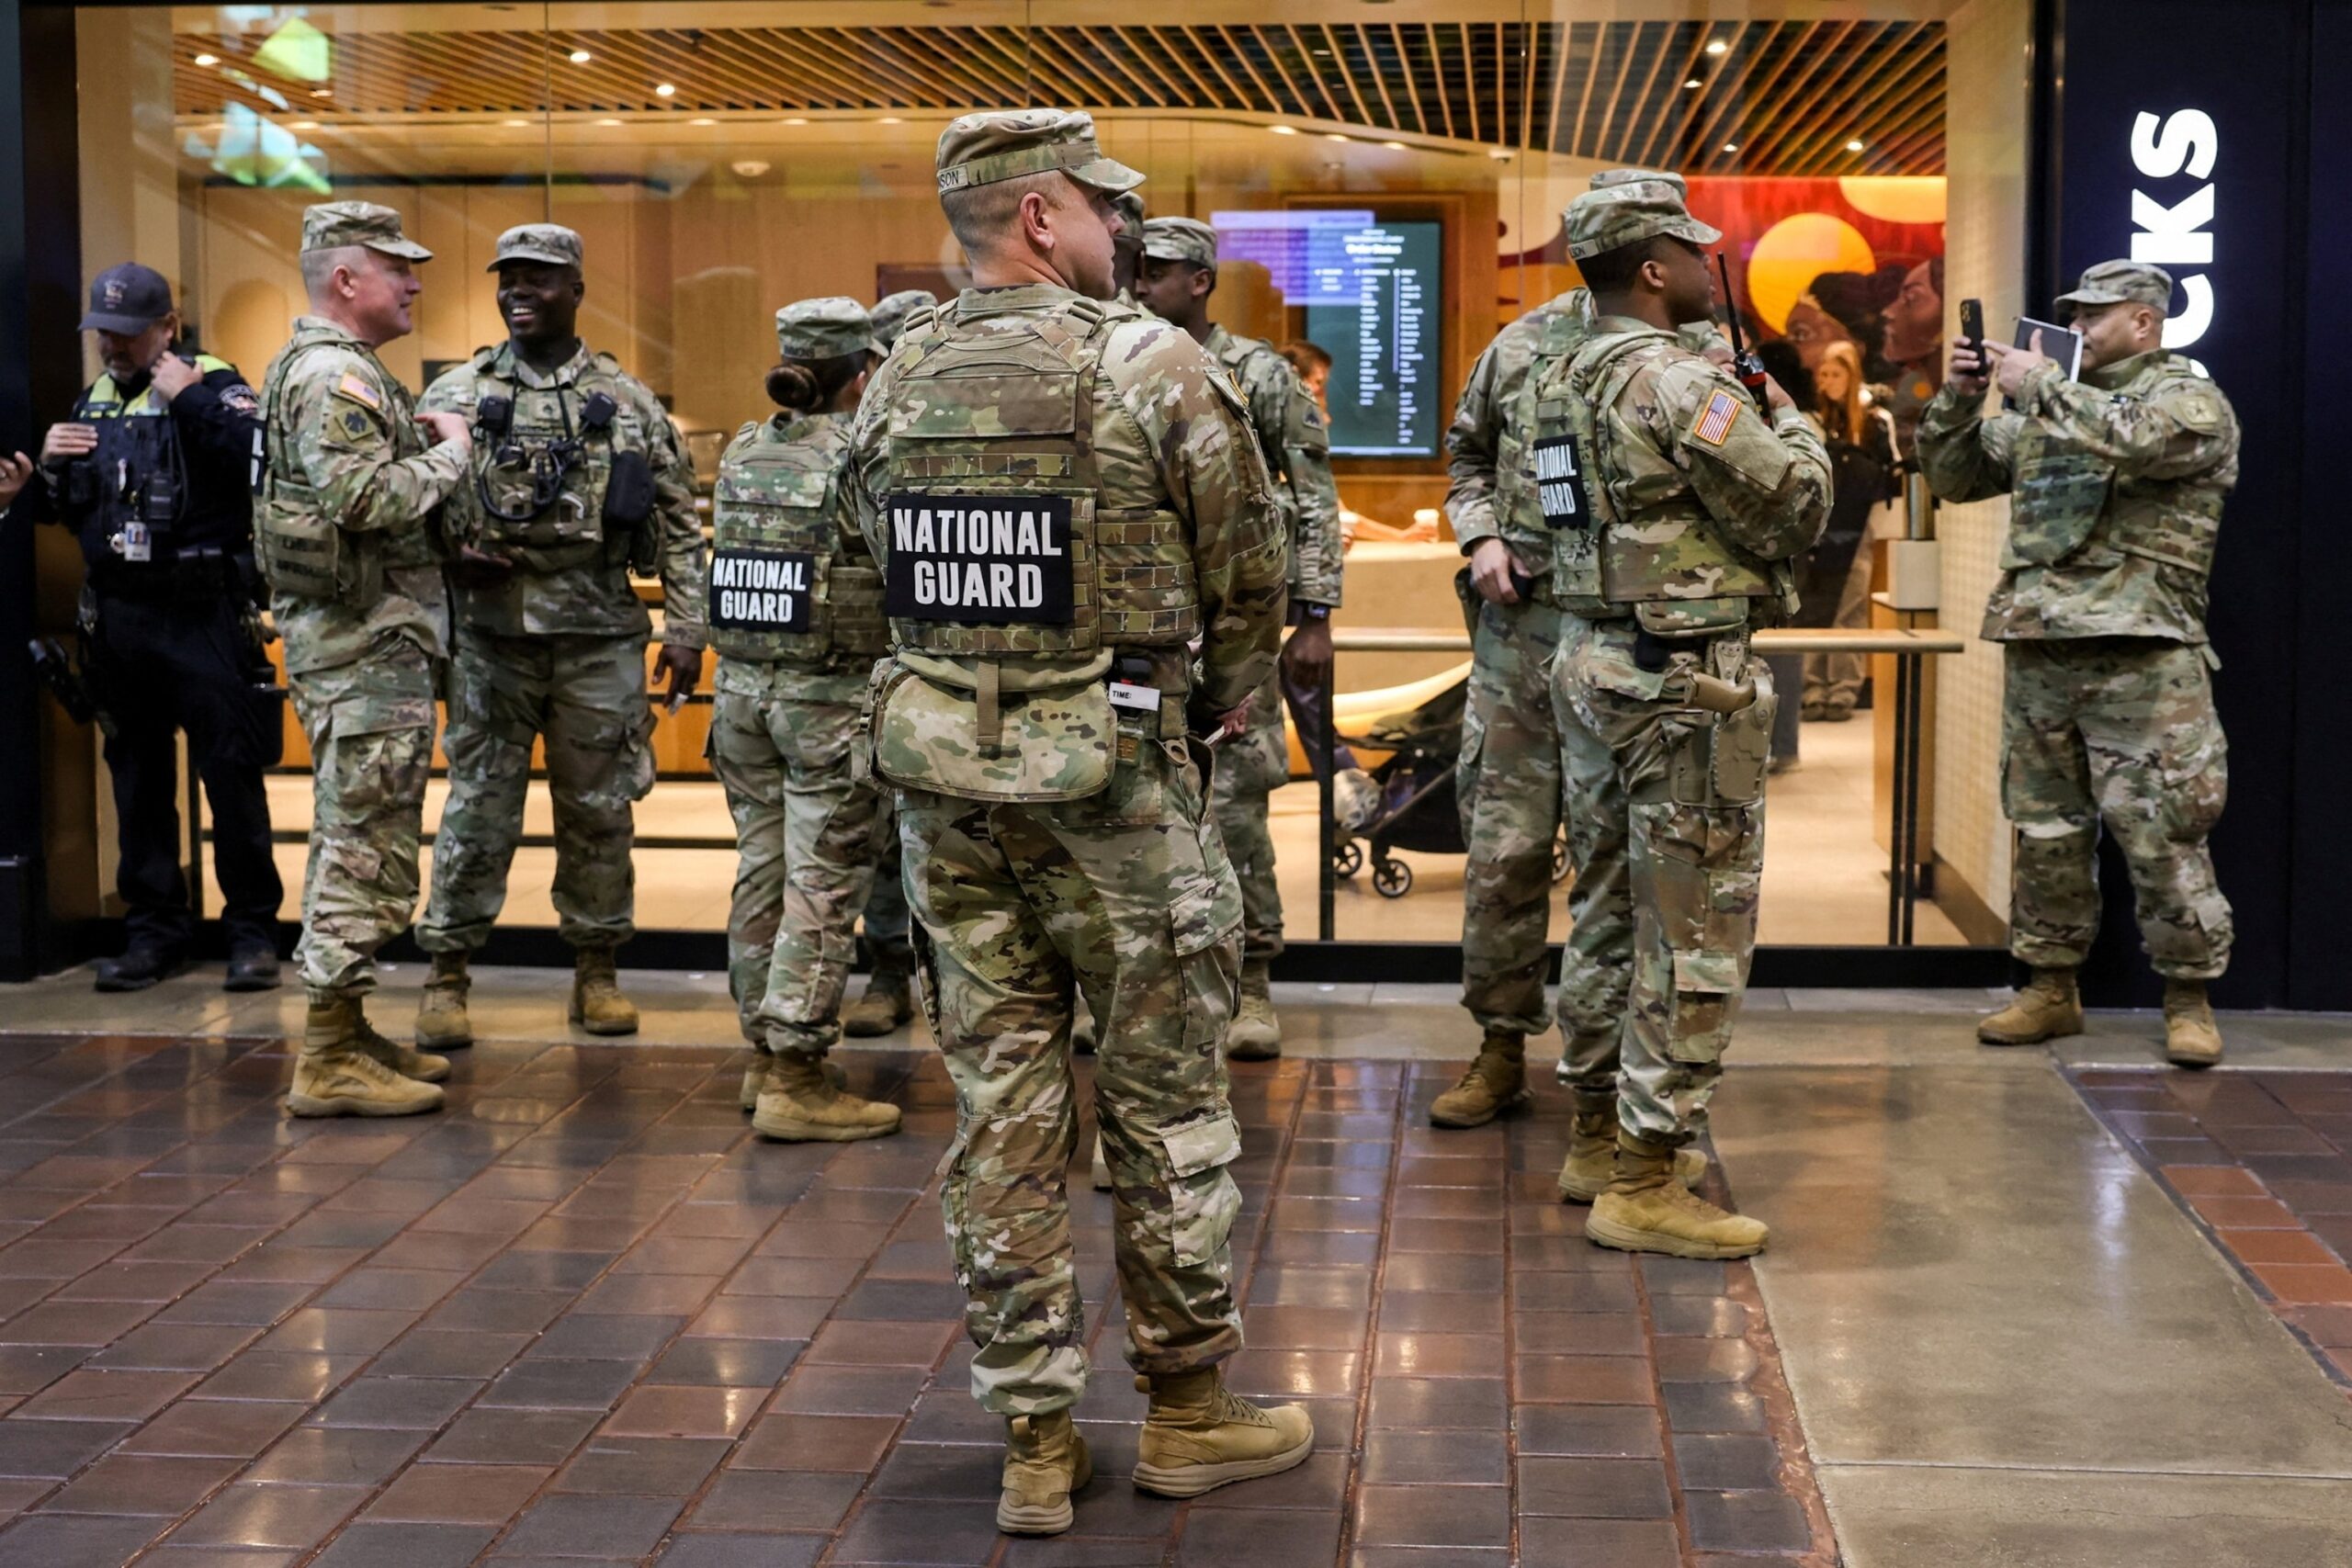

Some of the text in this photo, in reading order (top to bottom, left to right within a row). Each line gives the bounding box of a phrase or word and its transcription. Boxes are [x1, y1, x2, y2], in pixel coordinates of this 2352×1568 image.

[2130, 107, 2218, 378] CKS
[893, 508, 1062, 557] NATIONAL
[712, 557, 807, 592] NATIONAL
[913, 560, 1044, 608] GUARD
[720, 589, 793, 623] GUARD
[1112, 690, 1132, 699] TIME:
